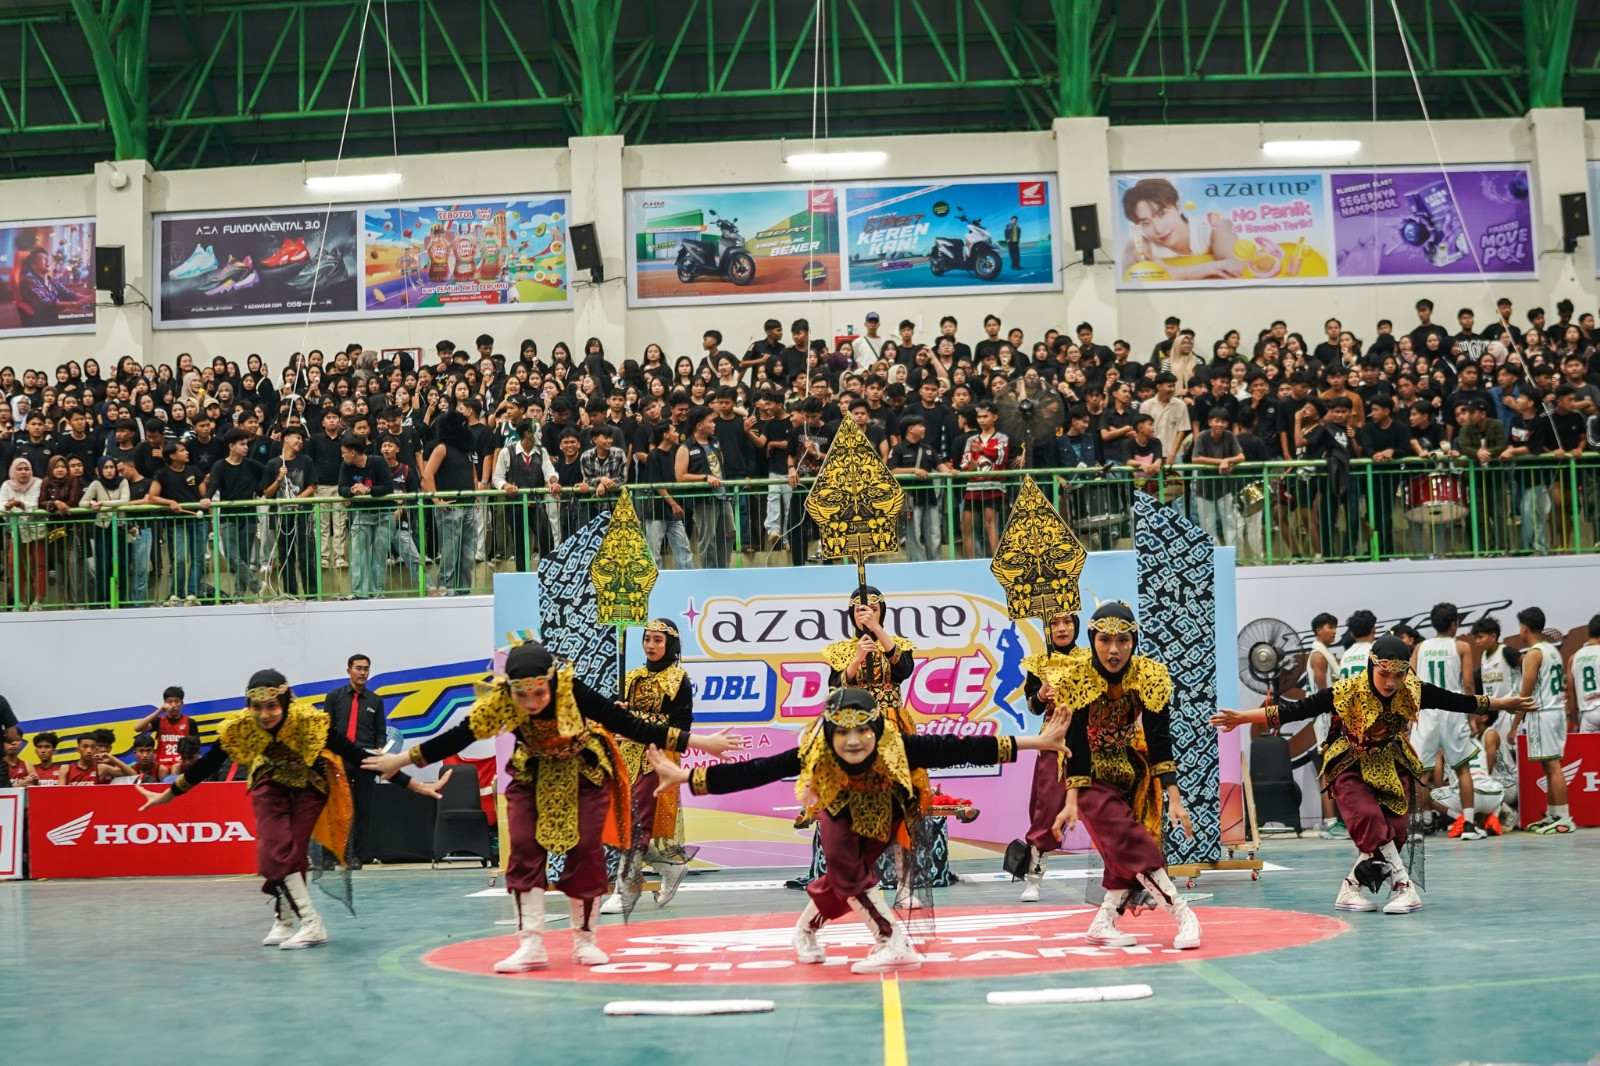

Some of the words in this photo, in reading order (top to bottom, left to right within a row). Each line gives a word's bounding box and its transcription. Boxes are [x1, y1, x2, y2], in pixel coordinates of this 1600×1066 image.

[1339, 188, 1396, 207] SEGERNYA
[438, 210, 473, 220] SEBOTOL
[1232, 208, 1257, 222] No
[1260, 201, 1312, 219] Panik
[223, 221, 303, 234] FUNDAMENTAL
[305, 220, 320, 230] 3.0
[857, 222, 930, 245] KEREN
[869, 236, 919, 255] KAN!
[1481, 229, 1527, 247] MOVE
[770, 241, 820, 256] BENER
[436, 284, 460, 293] SEMUA
[712, 605, 966, 642] azarne
[701, 676, 760, 701] DBL
[780, 649, 992, 717] DCE
[1428, 660, 1445, 688] 11
[1583, 666, 1596, 692] 8
[94, 821, 255, 845] HONDA
